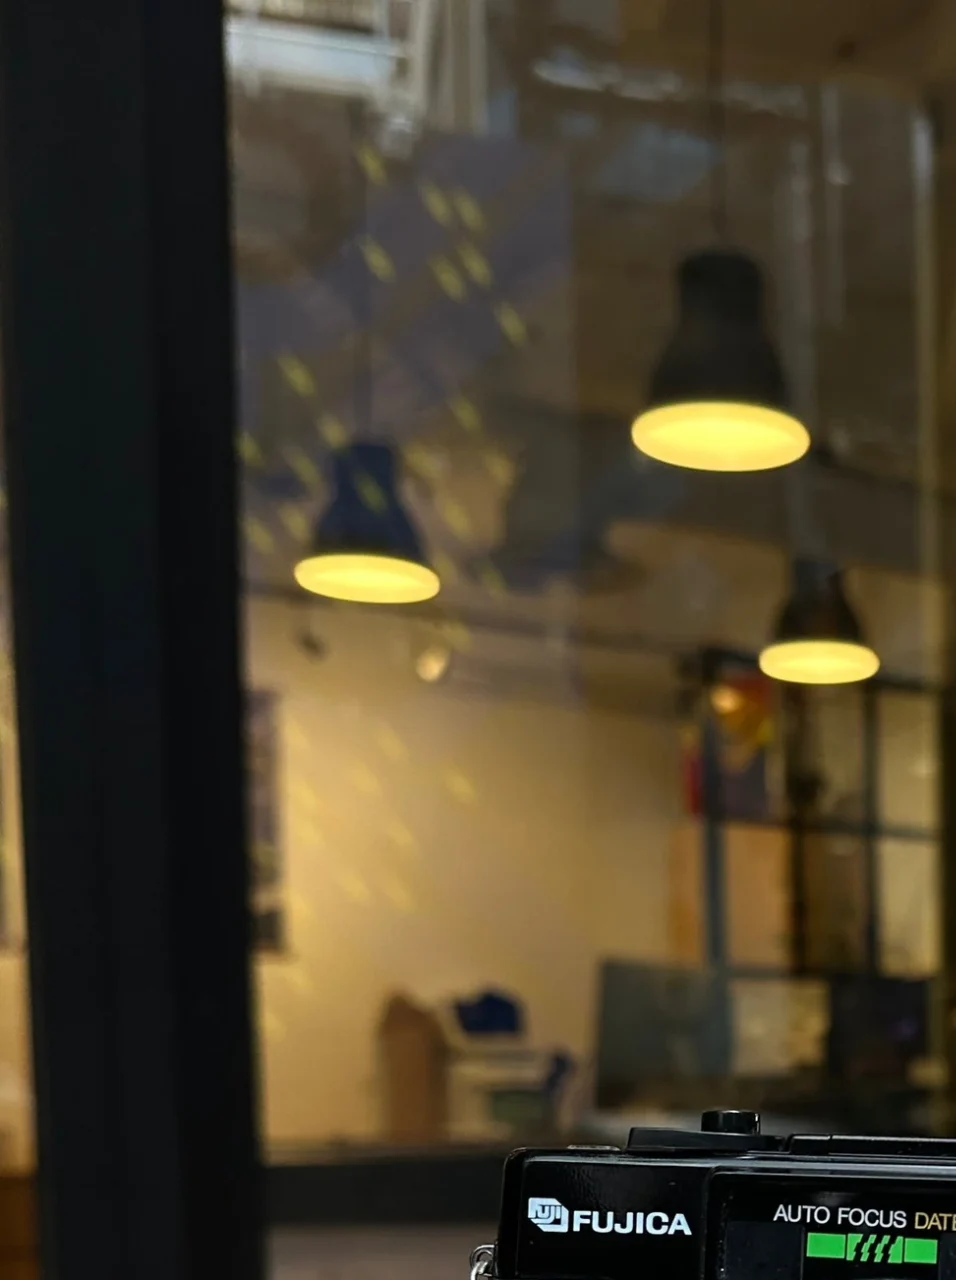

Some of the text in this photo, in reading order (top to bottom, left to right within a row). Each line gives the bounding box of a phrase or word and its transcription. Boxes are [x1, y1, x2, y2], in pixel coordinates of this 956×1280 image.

[573, 1210, 692, 1236] FUJICA
[773, 1204, 831, 1224] AUTO
[837, 1206, 907, 1228] FOCUS
